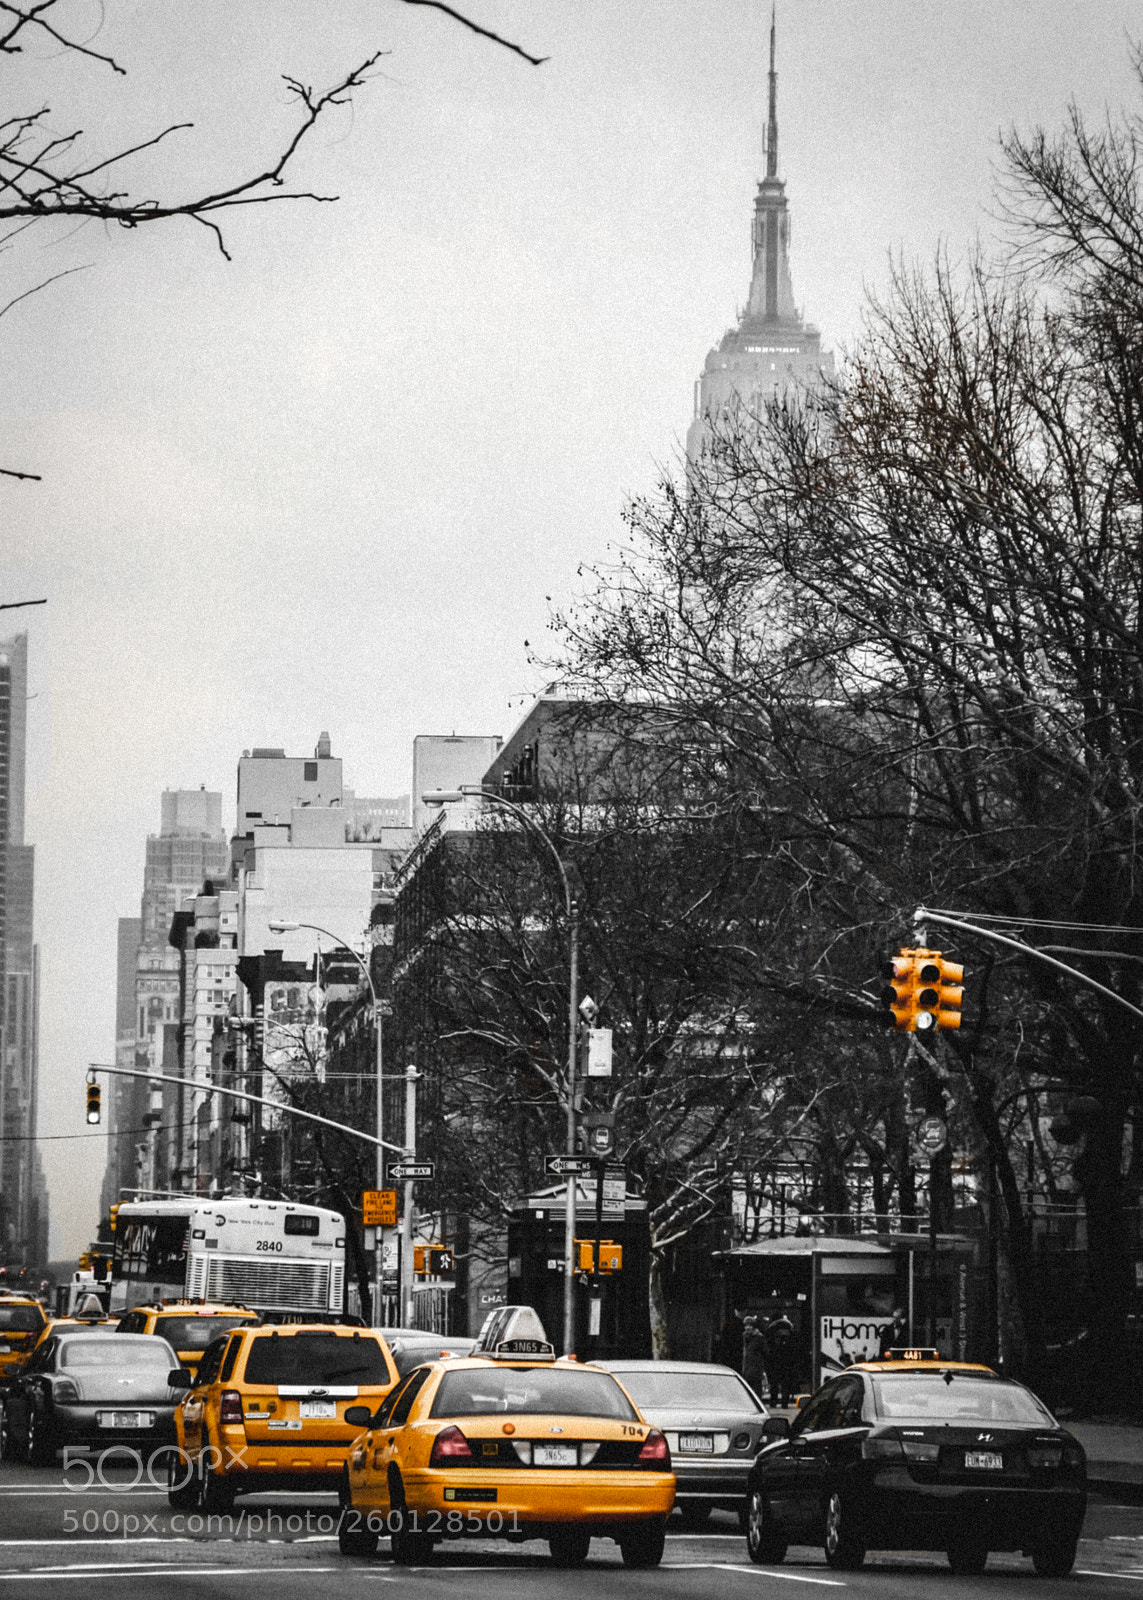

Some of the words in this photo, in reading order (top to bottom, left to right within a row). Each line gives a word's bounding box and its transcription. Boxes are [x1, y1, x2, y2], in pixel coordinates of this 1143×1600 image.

[394, 1167, 407, 1175] ONE
[414, 1167, 428, 1175] WAY
[256, 1240, 283, 1252] 2840
[513, 1342, 537, 1352] 3N65
[903, 1351, 922, 1360] 4A81
[621, 1425, 643, 1437] 704
